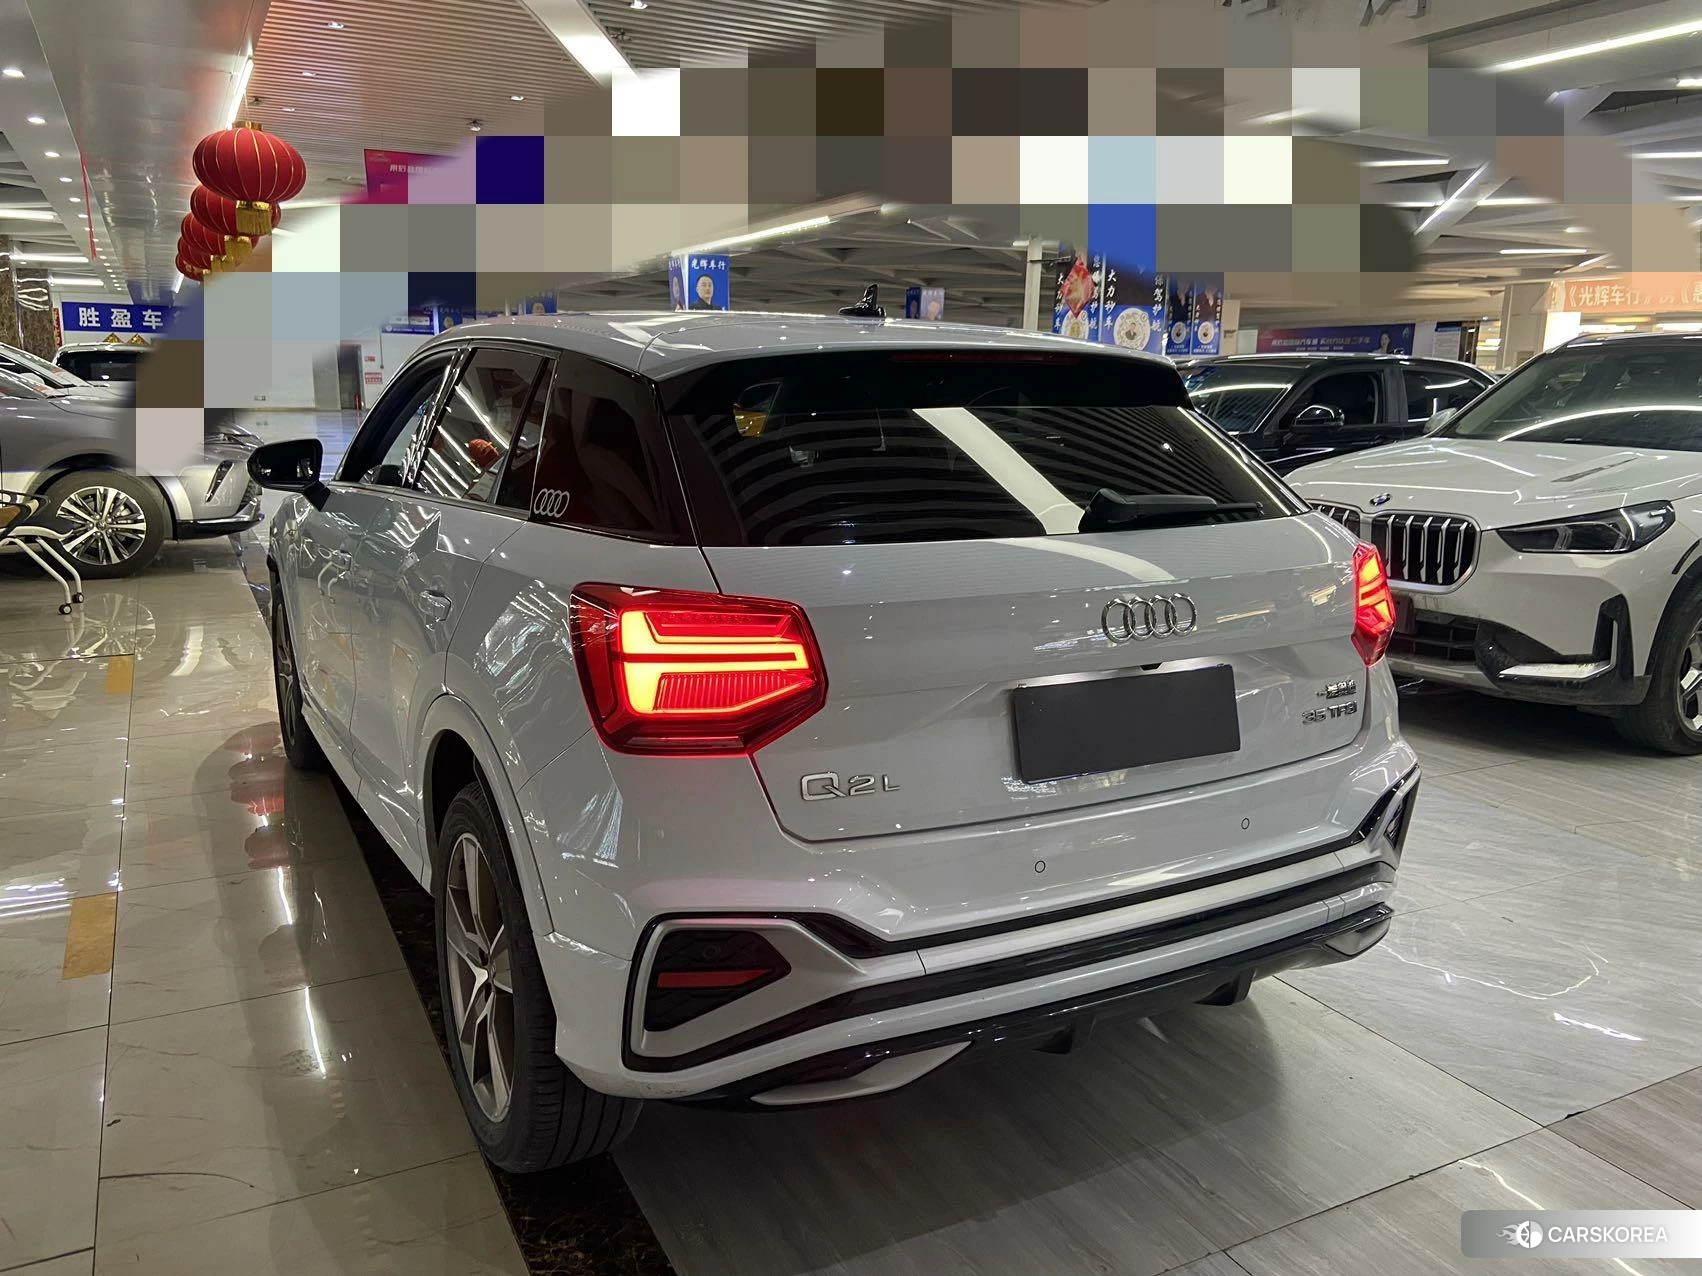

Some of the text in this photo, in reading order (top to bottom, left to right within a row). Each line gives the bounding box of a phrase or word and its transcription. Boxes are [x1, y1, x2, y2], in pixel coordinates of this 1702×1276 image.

[78, 306, 181, 330] 胜盈车
[1301, 708, 1327, 725] 35
